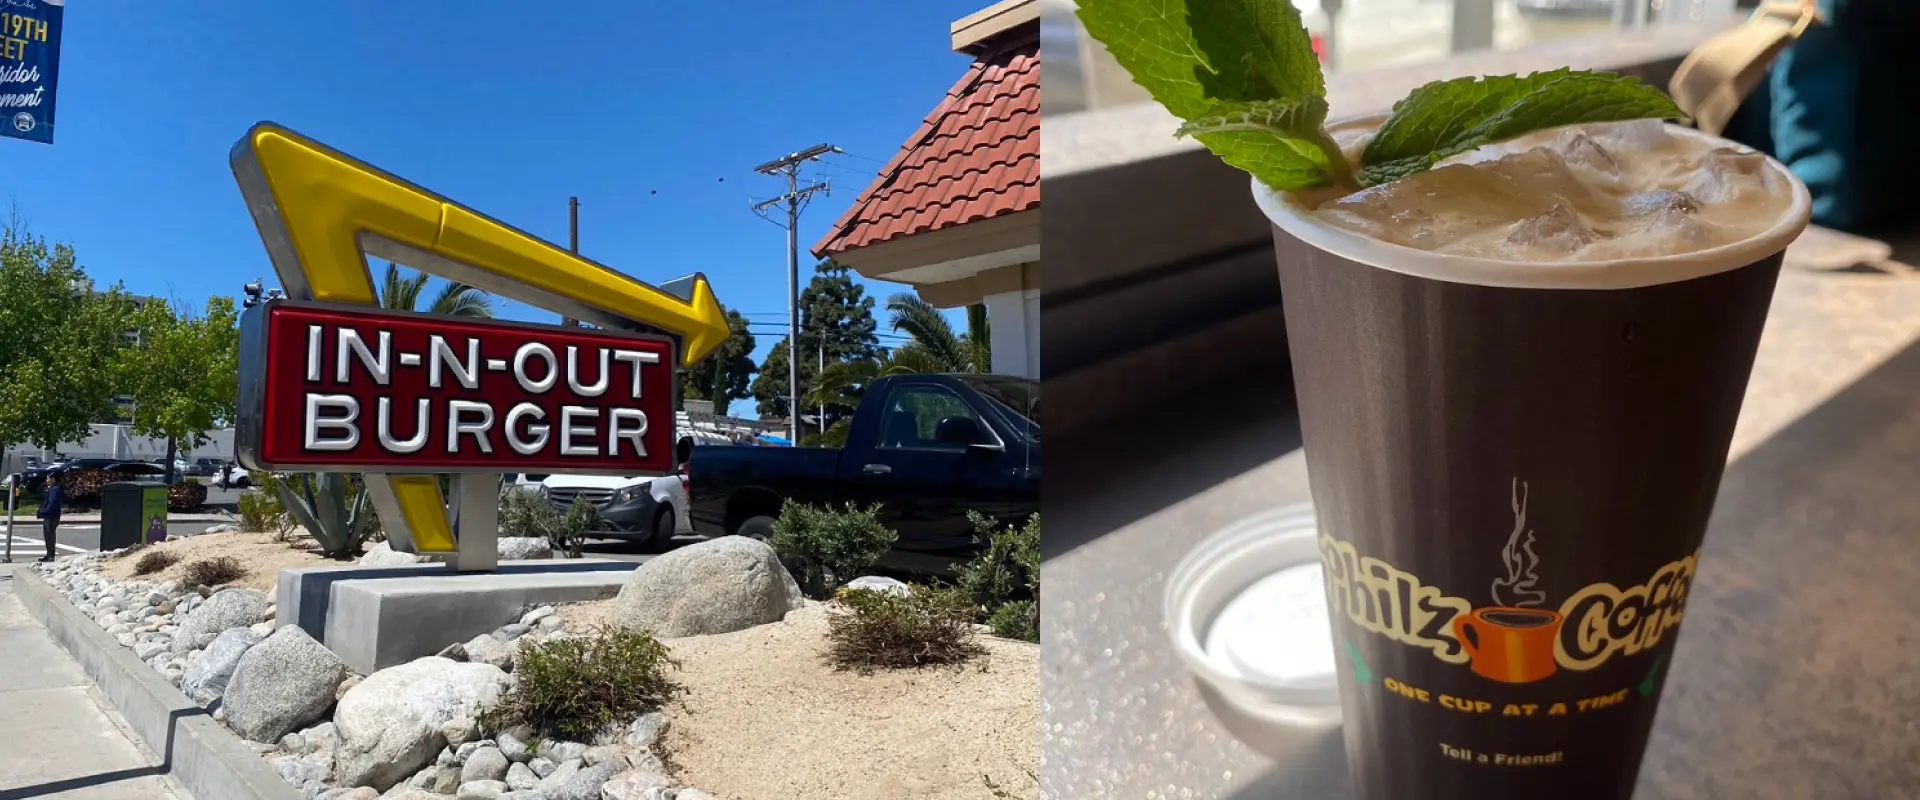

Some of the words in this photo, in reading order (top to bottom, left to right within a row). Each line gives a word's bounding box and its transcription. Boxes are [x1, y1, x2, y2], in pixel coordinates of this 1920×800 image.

[2, 13, 47, 42] 19TH
[307, 325, 660, 398] IN-N-OUT
[305, 393, 648, 457] BURGER
[1553, 548, 1701, 672] Coffe
[1384, 677, 1430, 703] ONE
[1439, 694, 1492, 713] CUP
[1502, 704, 1540, 716] AT
[1548, 703, 1567, 715] A
[1577, 688, 1628, 712] TIME
[1439, 743, 1471, 761] Tell
[1477, 753, 1488, 763] a
[1494, 751, 1564, 766] Friend!
